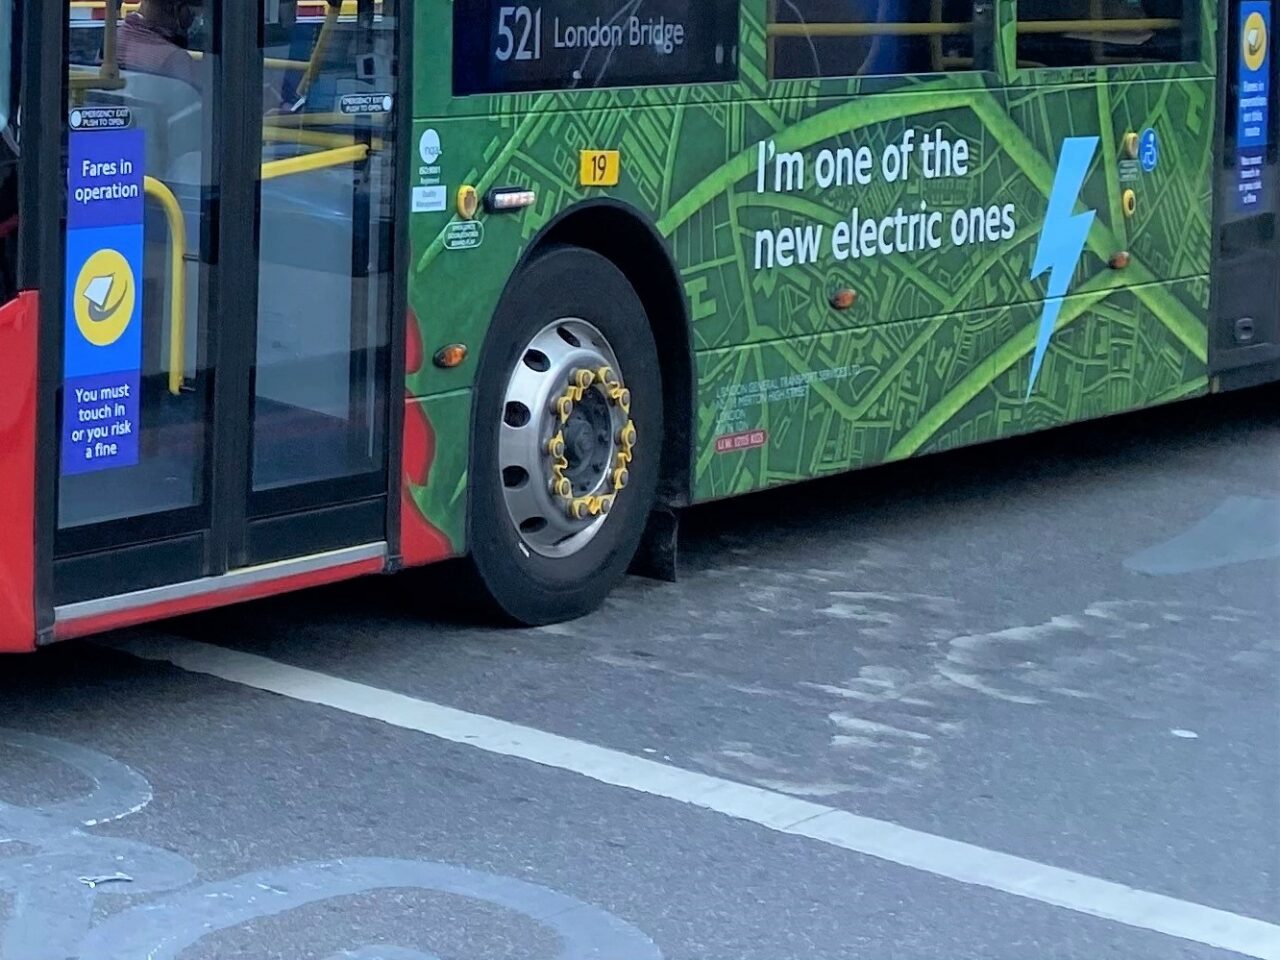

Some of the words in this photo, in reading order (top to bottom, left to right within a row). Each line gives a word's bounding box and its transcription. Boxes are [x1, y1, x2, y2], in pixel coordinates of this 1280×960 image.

[495, 6, 541, 61] 521
[554, 16, 623, 48] London
[629, 16, 685, 54] Bridge
[82, 159, 117, 177] Fares
[120, 158, 132, 174] in
[591, 154, 607, 182] 19
[757, 140, 804, 193] I'm
[815, 144, 872, 188] one
[882, 129, 915, 182] of
[921, 128, 969, 179] the
[75, 182, 138, 205] operation
[754, 224, 823, 270] new
[832, 200, 942, 261] electric
[951, 203, 1015, 246] ones
[76, 388, 98, 404] You
[100, 383, 130, 400] must
[79, 405, 111, 422] touch
[115, 403, 126, 417] in
[72, 428, 84, 441] or
[87, 425, 108, 443] you
[111, 420, 132, 436] risk
[85, 446, 93, 460] a
[95, 443, 118, 458] fine
